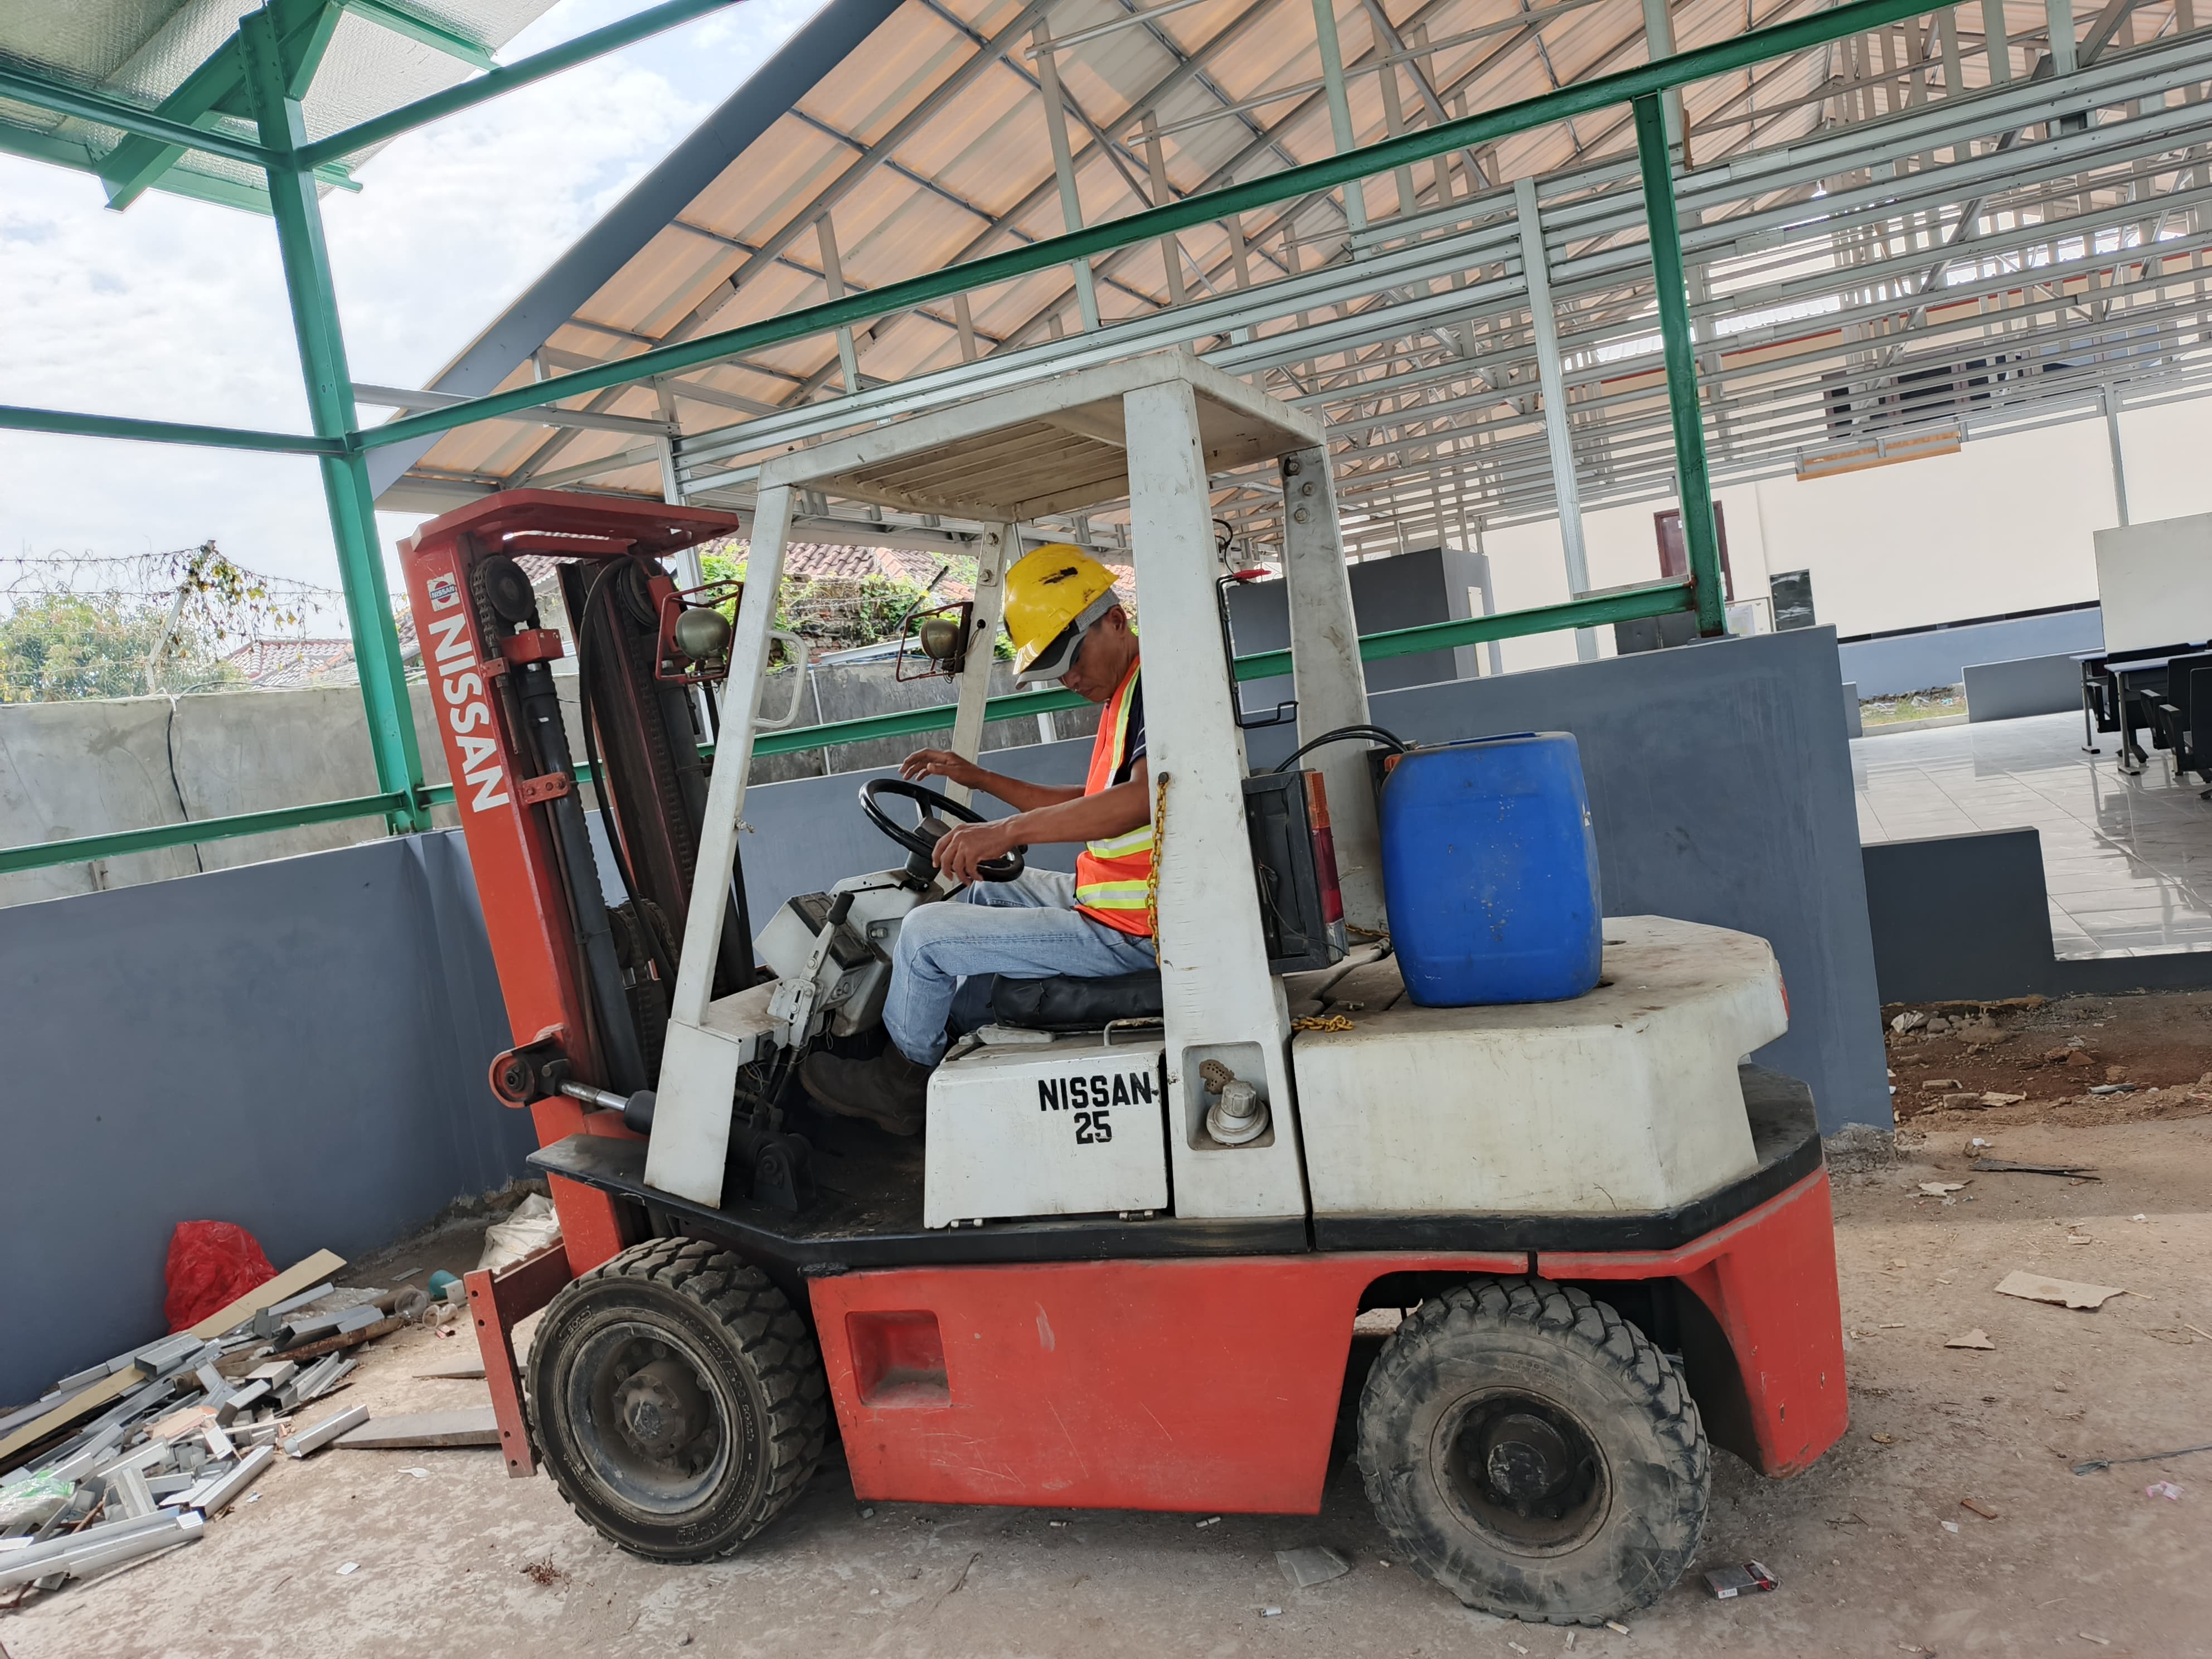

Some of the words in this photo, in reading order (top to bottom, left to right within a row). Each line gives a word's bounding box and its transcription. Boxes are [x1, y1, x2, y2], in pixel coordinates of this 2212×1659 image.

[431, 585, 455, 599] NISSAN
[428, 613, 510, 812] NISSAN
[1038, 1071, 1152, 1111] NISSAN
[1074, 1110, 1112, 1144] 25
